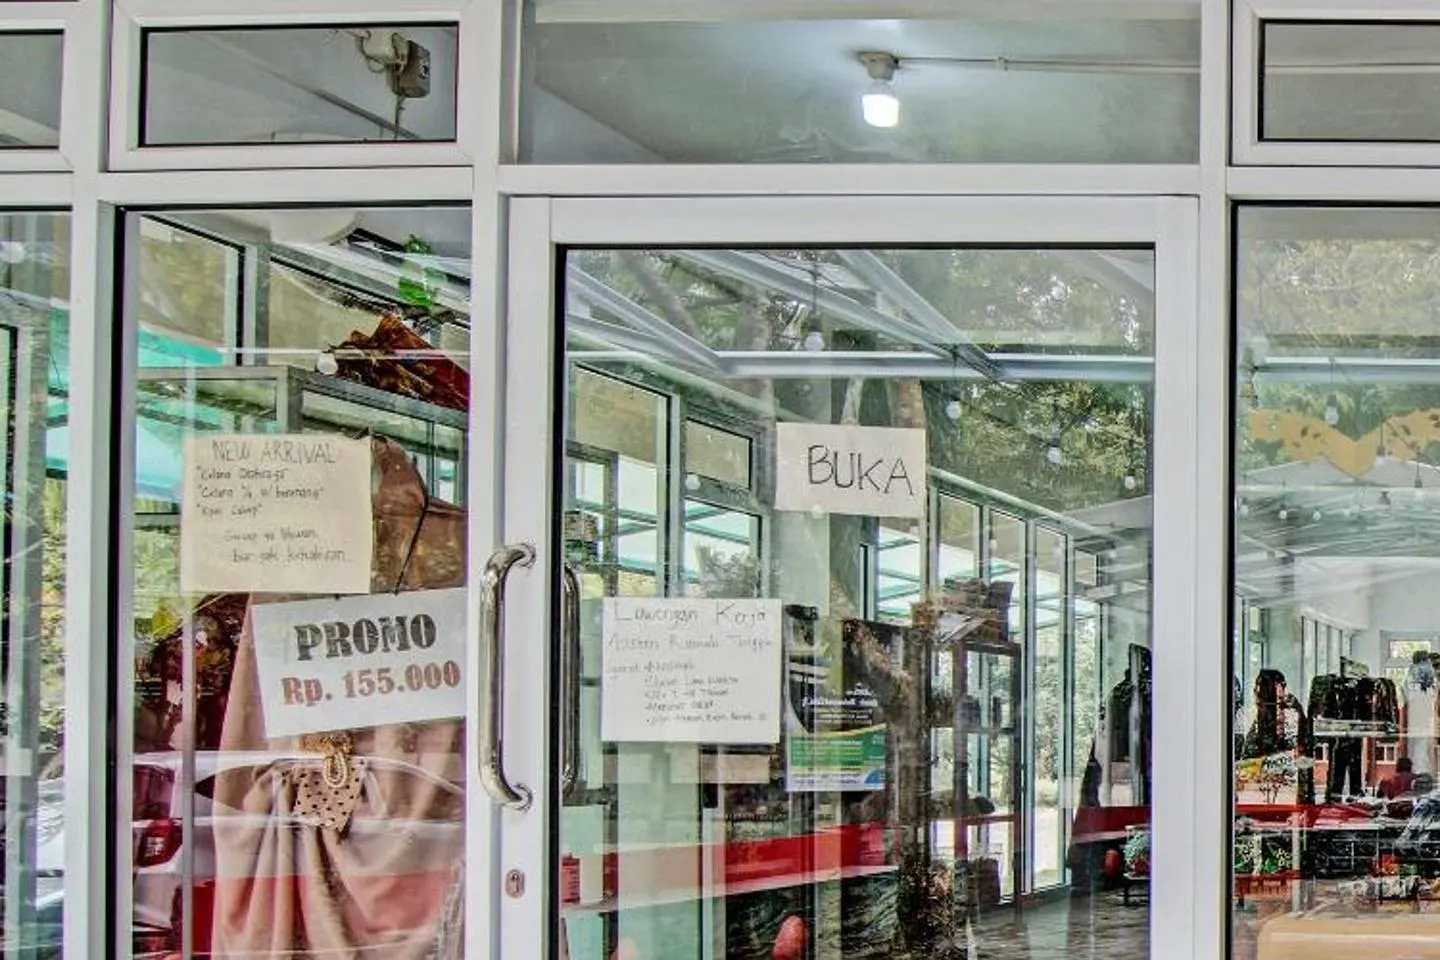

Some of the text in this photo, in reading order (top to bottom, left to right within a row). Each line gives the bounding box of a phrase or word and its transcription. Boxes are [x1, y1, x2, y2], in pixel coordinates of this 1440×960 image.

[212, 439, 336, 464] NEW ARRIVAL
[807, 444, 914, 496] BUKA
[293, 613, 438, 662] PROMO
[281, 660, 461, 708] Rp. 155.000
